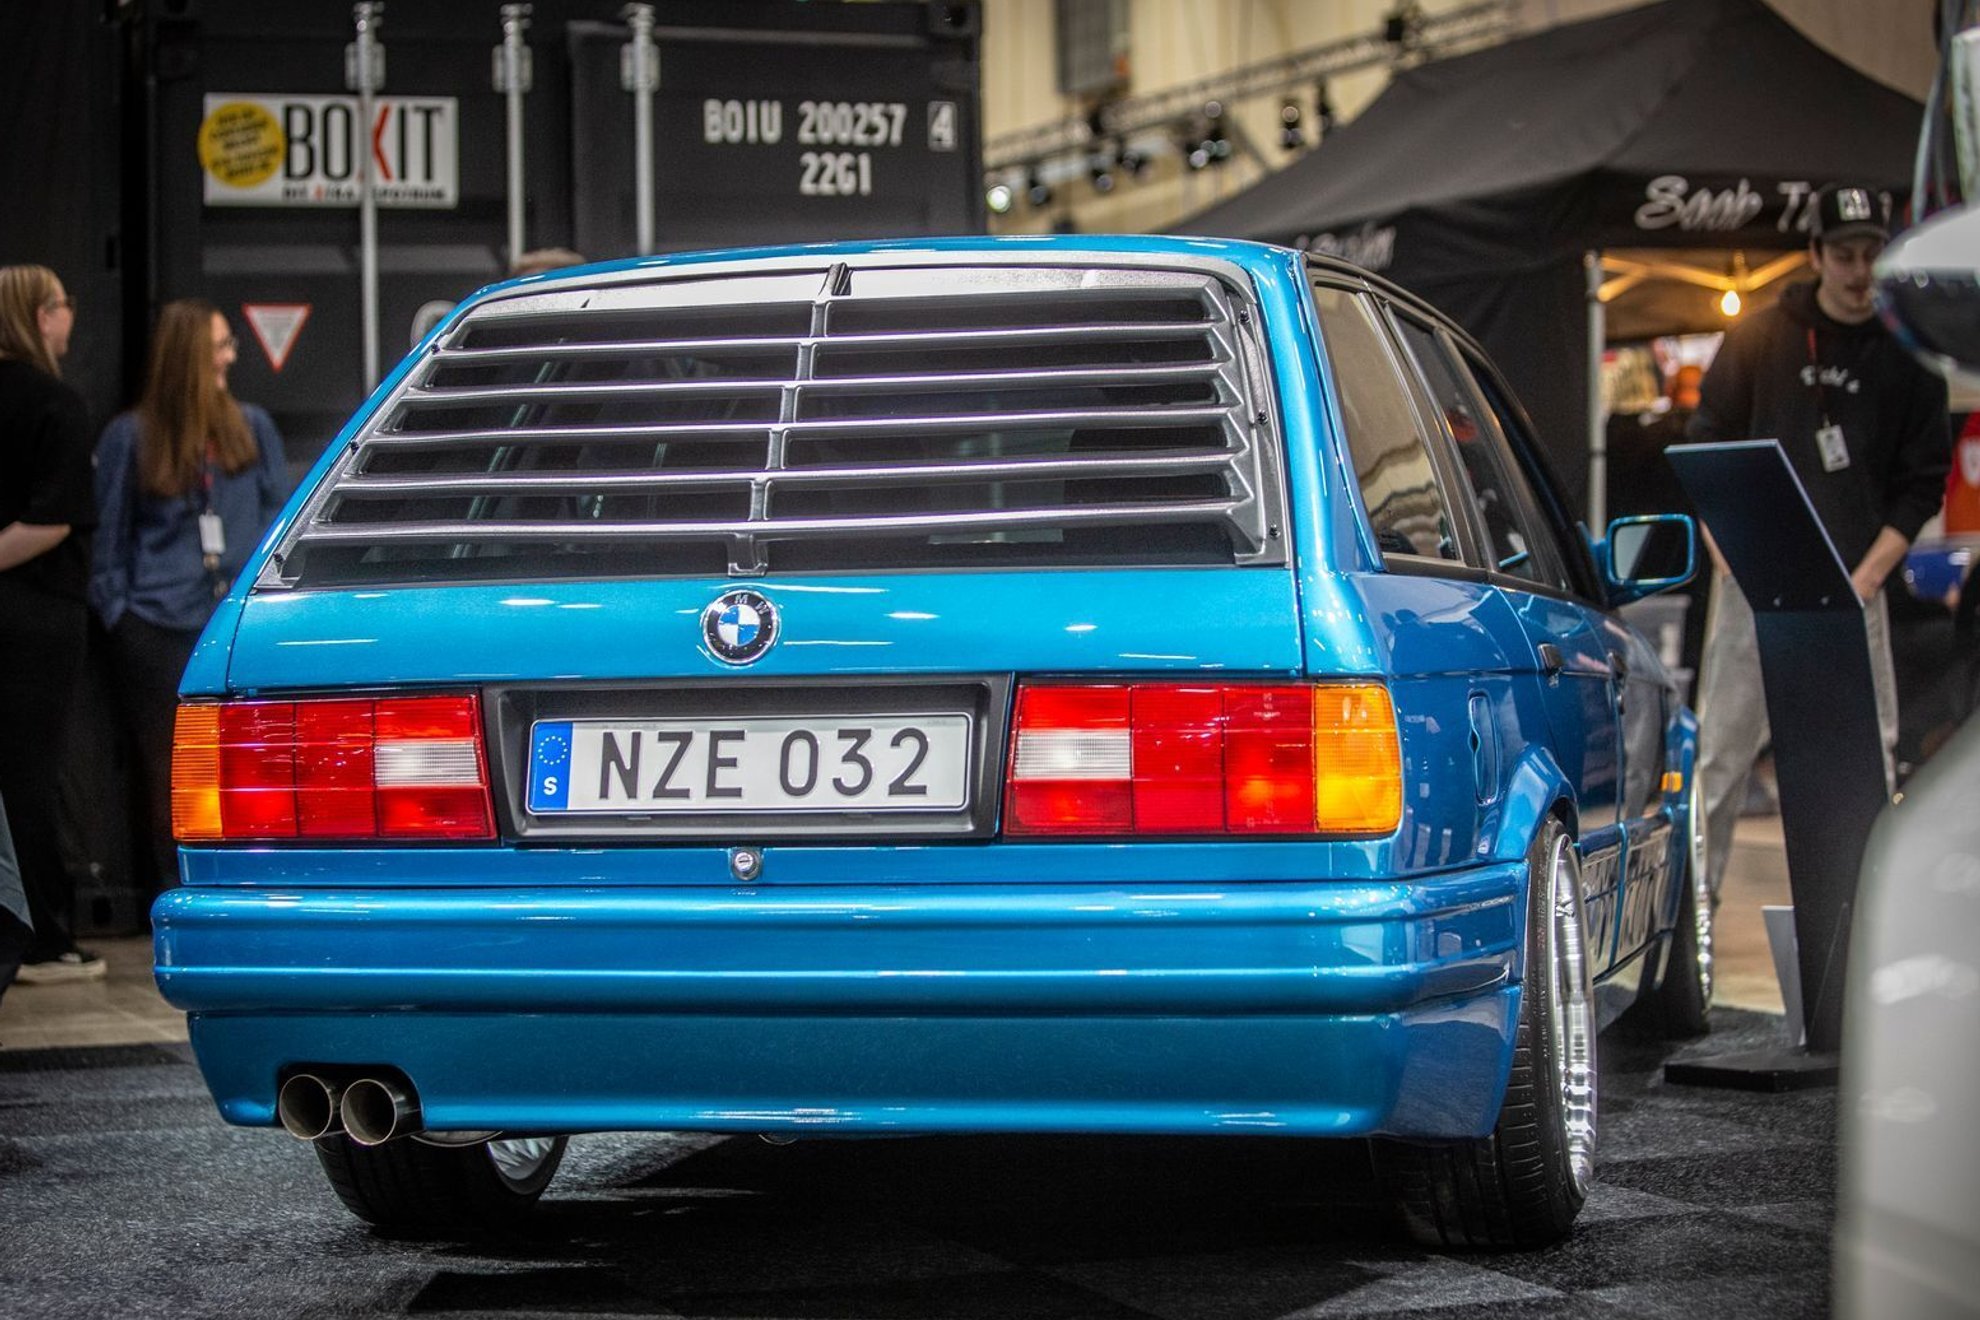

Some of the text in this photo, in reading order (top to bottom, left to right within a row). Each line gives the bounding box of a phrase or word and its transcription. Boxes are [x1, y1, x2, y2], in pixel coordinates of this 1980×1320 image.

[798, 101, 907, 147] 200257
[931, 104, 954, 148] 4
[543, 776, 558, 796] S
[599, 727, 929, 799] NZE 032
